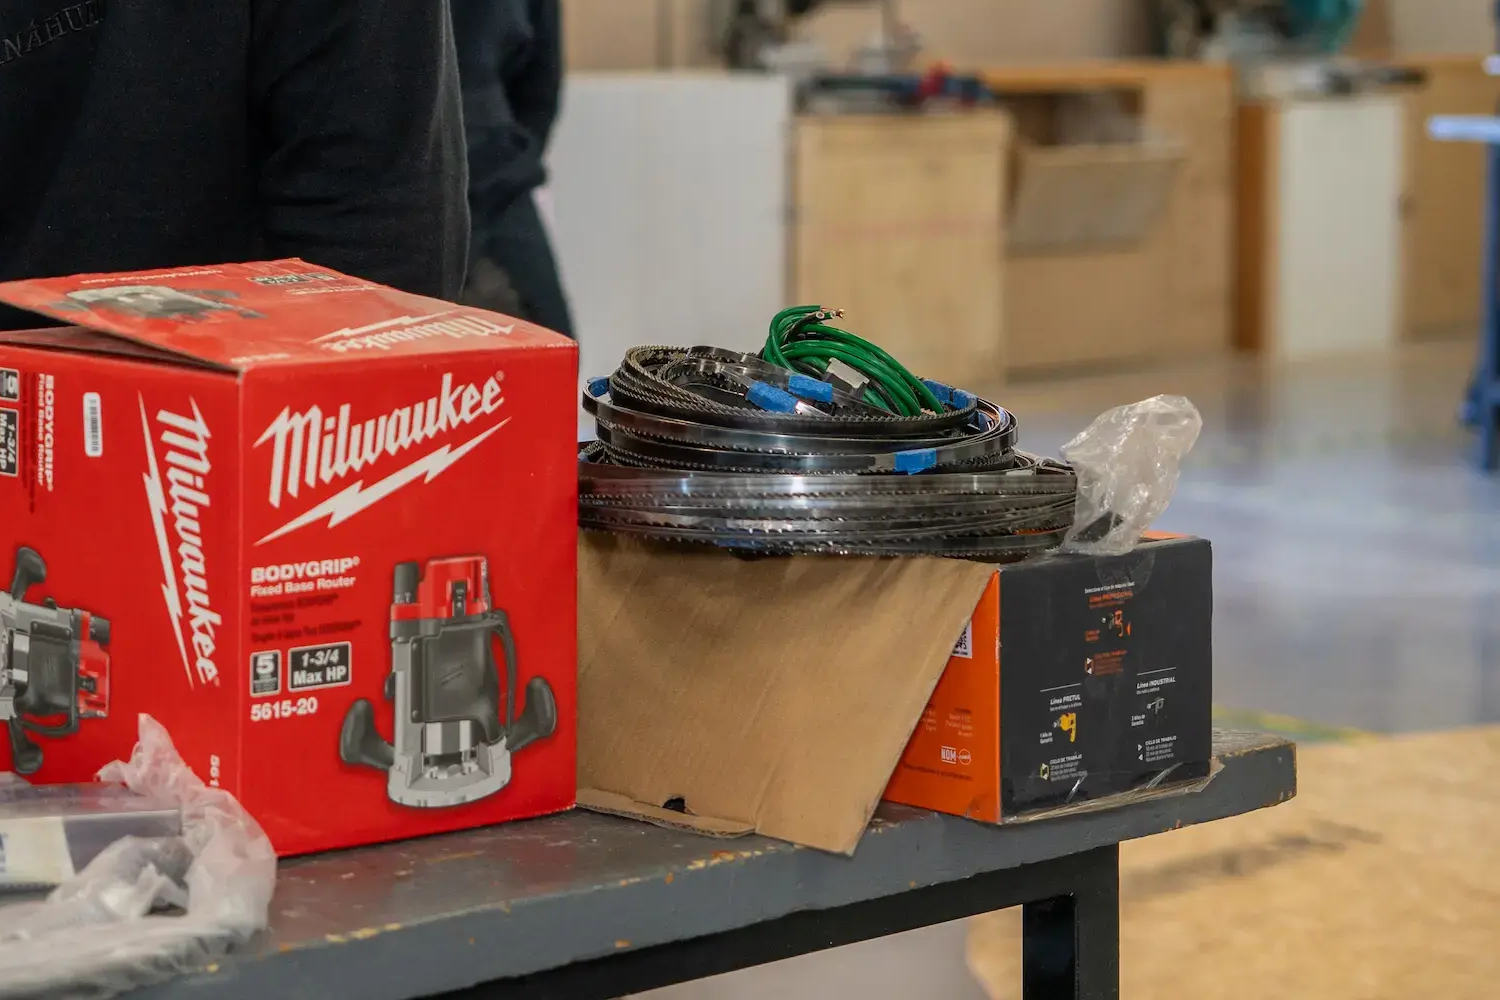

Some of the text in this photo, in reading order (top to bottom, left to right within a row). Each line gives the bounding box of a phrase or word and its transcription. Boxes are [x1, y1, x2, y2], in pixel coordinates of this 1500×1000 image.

[0, 413, 8, 443] Max
[252, 371, 505, 509] Milwaukee
[156, 395, 222, 686] Milwaukee
[251, 576, 356, 597] Fixed Base Router
[256, 654, 275, 675] 5
[302, 649, 340, 667] 1-3/4
[293, 671, 323, 686] Max
[326, 665, 347, 682] HP
[251, 697, 318, 722] 5615-20
